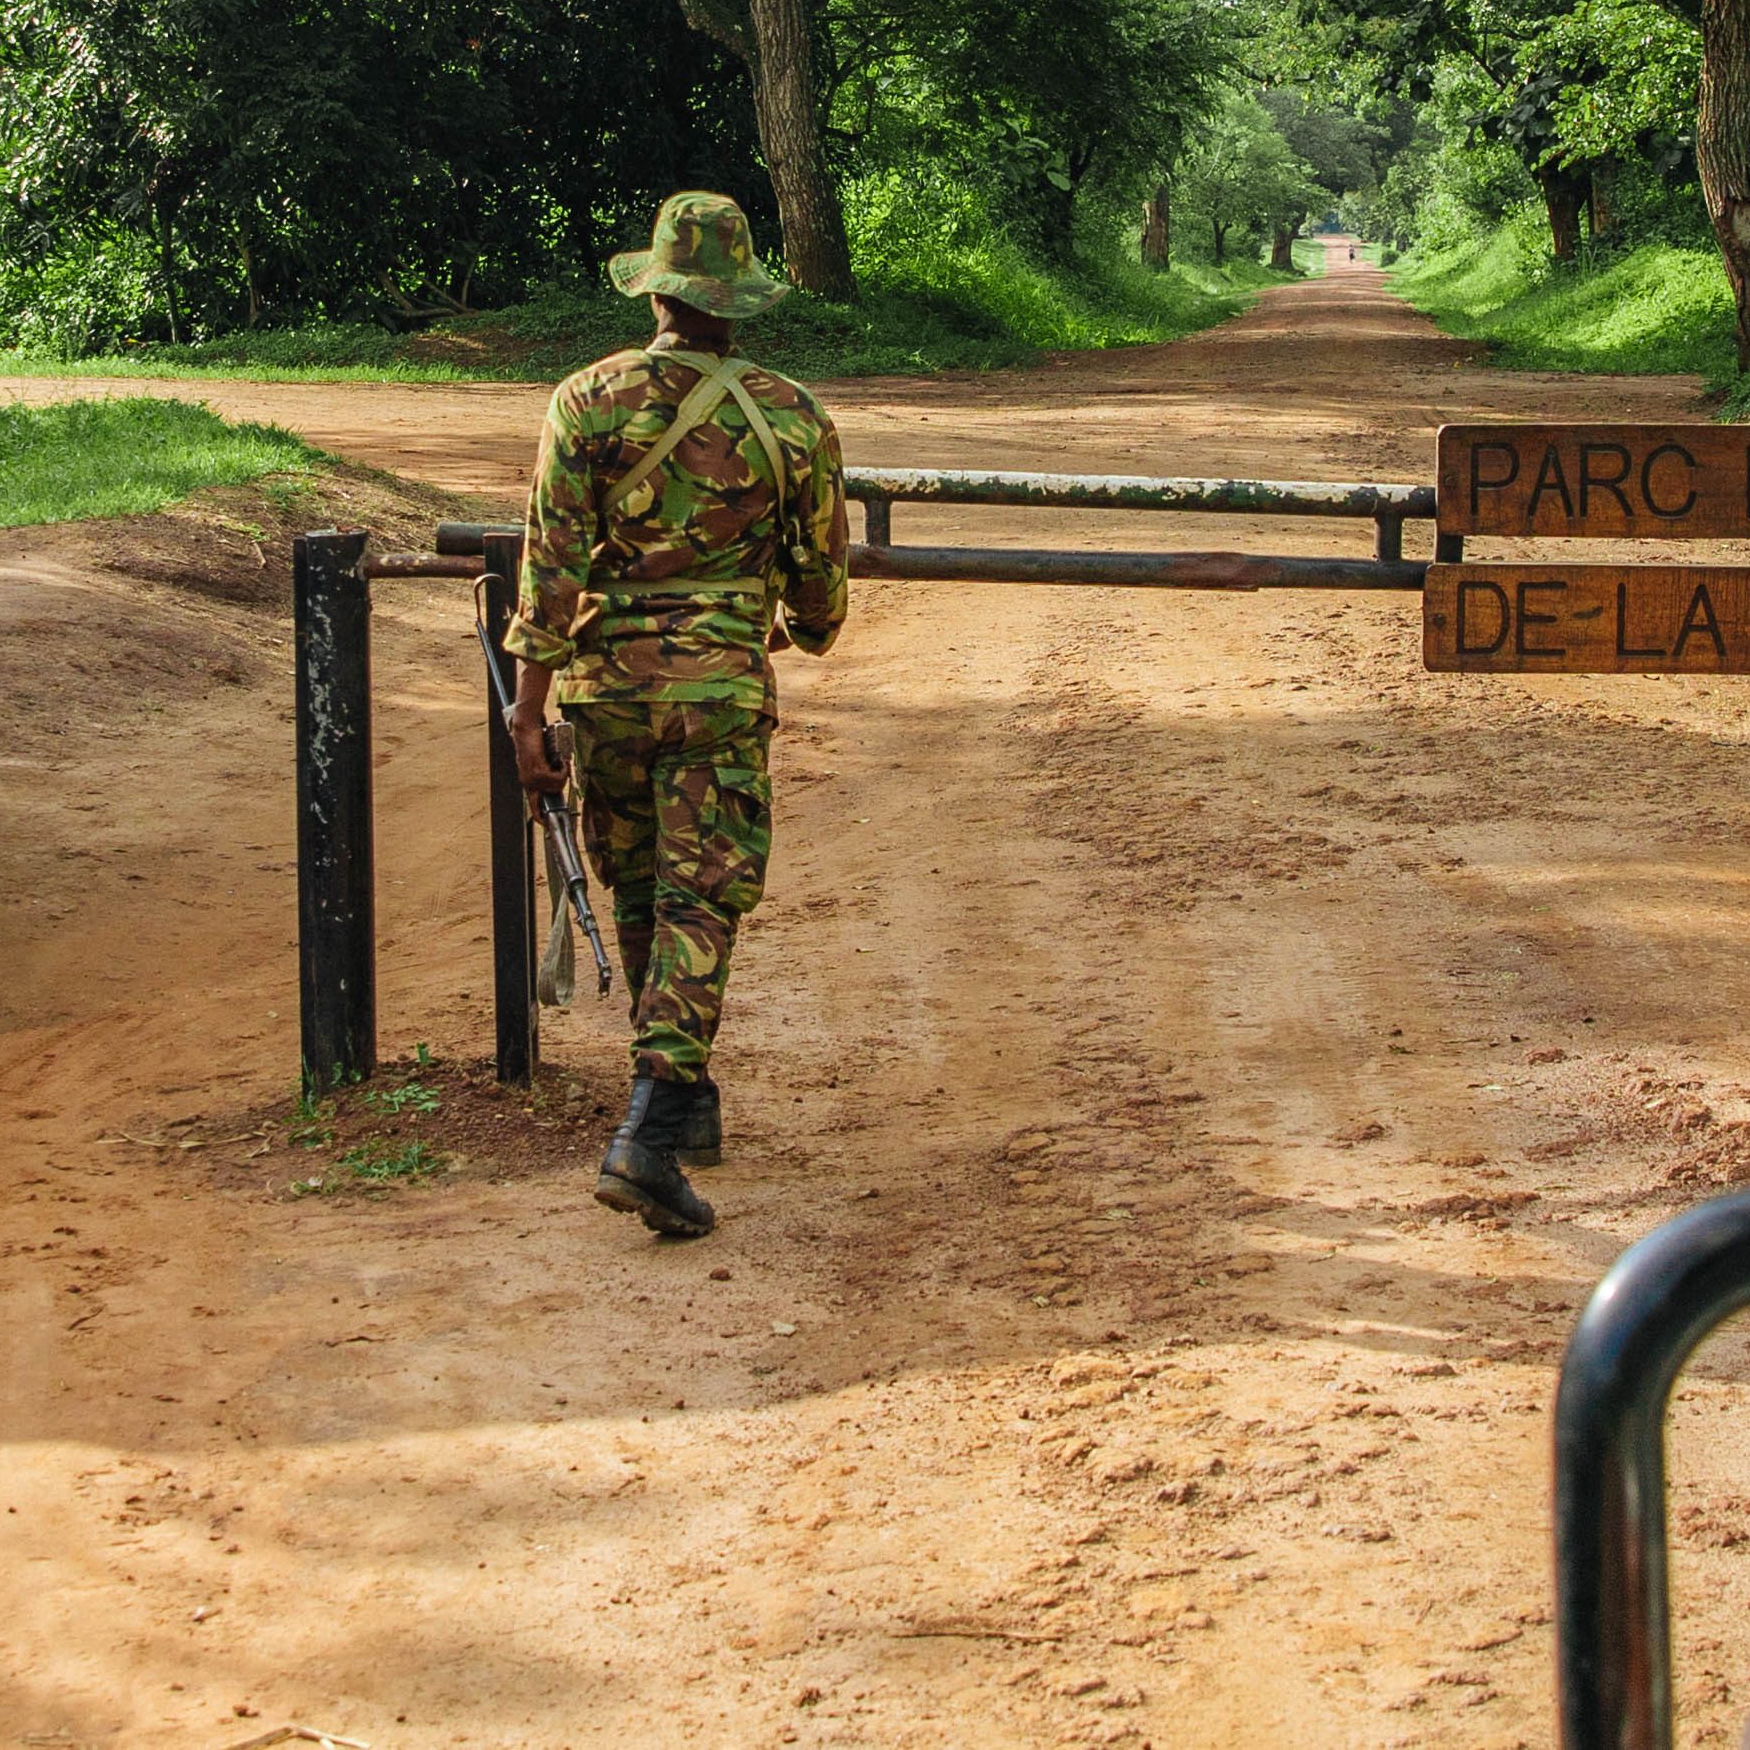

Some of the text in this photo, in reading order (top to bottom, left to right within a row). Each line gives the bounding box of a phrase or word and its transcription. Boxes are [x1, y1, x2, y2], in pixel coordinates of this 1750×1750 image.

[1469, 442, 1698, 519] PARC
[1455, 581, 1568, 656] DE
[1616, 583, 1728, 657] LA
